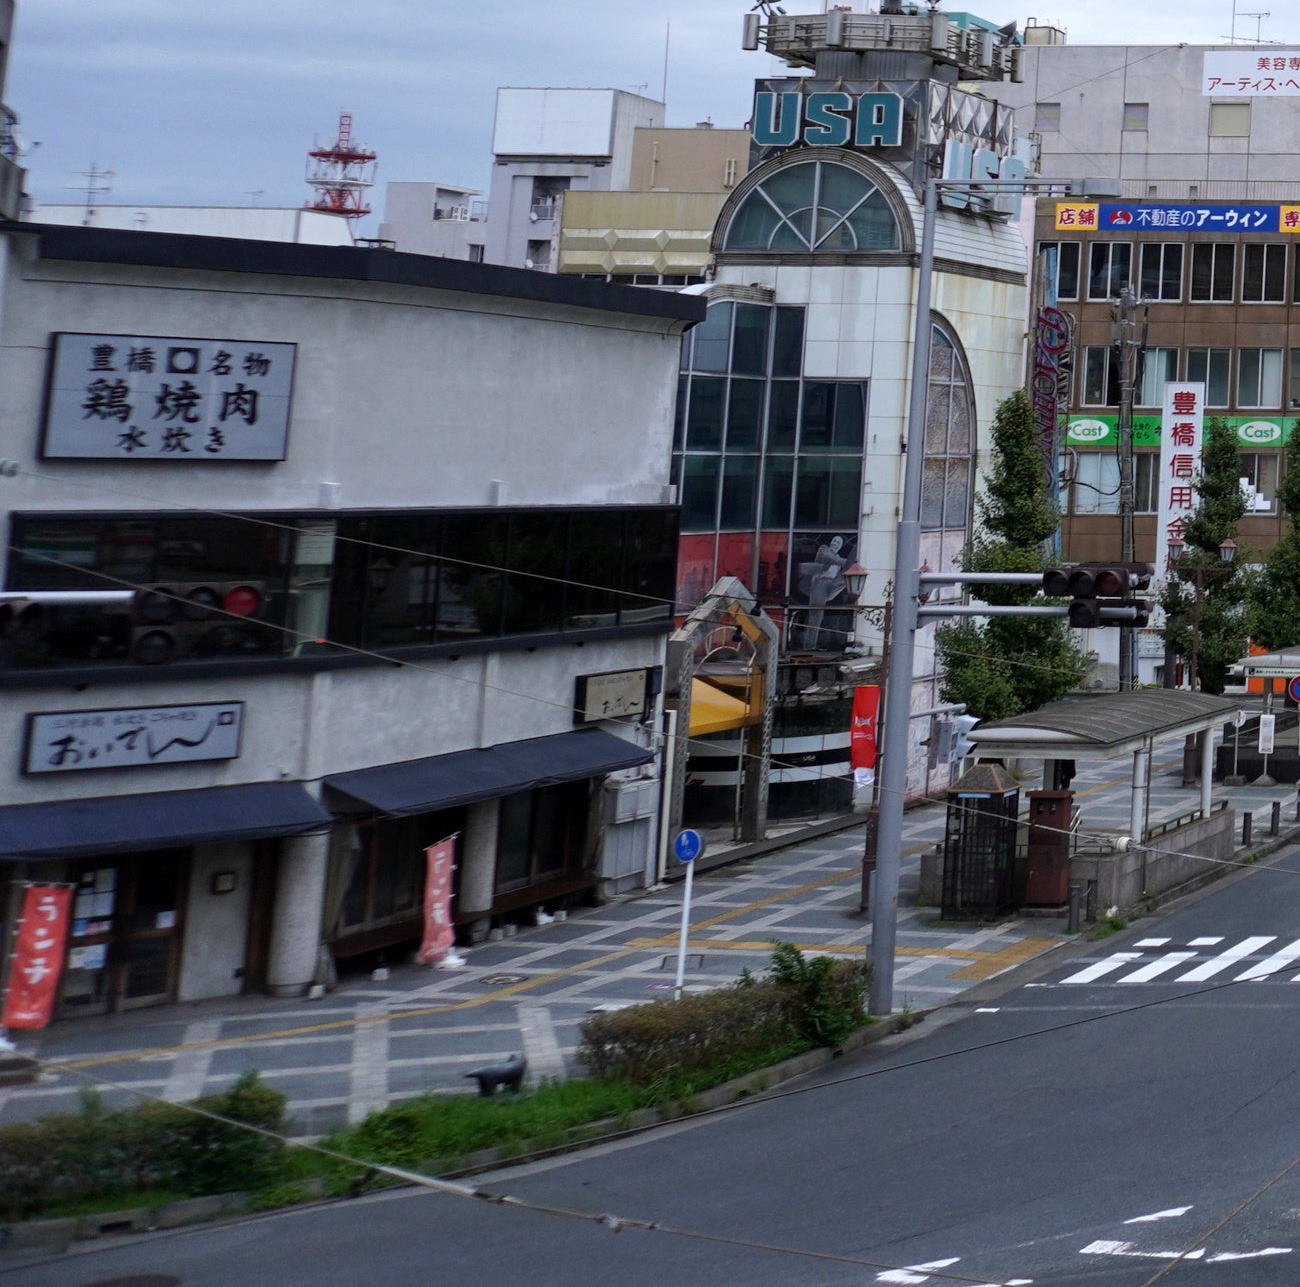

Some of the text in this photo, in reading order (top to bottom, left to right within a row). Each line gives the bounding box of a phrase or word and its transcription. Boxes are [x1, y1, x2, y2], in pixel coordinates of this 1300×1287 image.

[752, 91, 904, 147] USA
[1059, 208, 1095, 226] 店舗
[1136, 208, 1268, 227] 不動産のアーウィン
[88, 344, 272, 377] 豊橋 名物
[82, 377, 260, 426] 鶏焼肉
[115, 425, 226, 453] 水炊き
[1072, 423, 1102, 437] Cast
[1244, 424, 1275, 438] Cast
[1163, 391, 1197, 573] 豊橋信用金
[23, 895, 58, 984] ランチ
